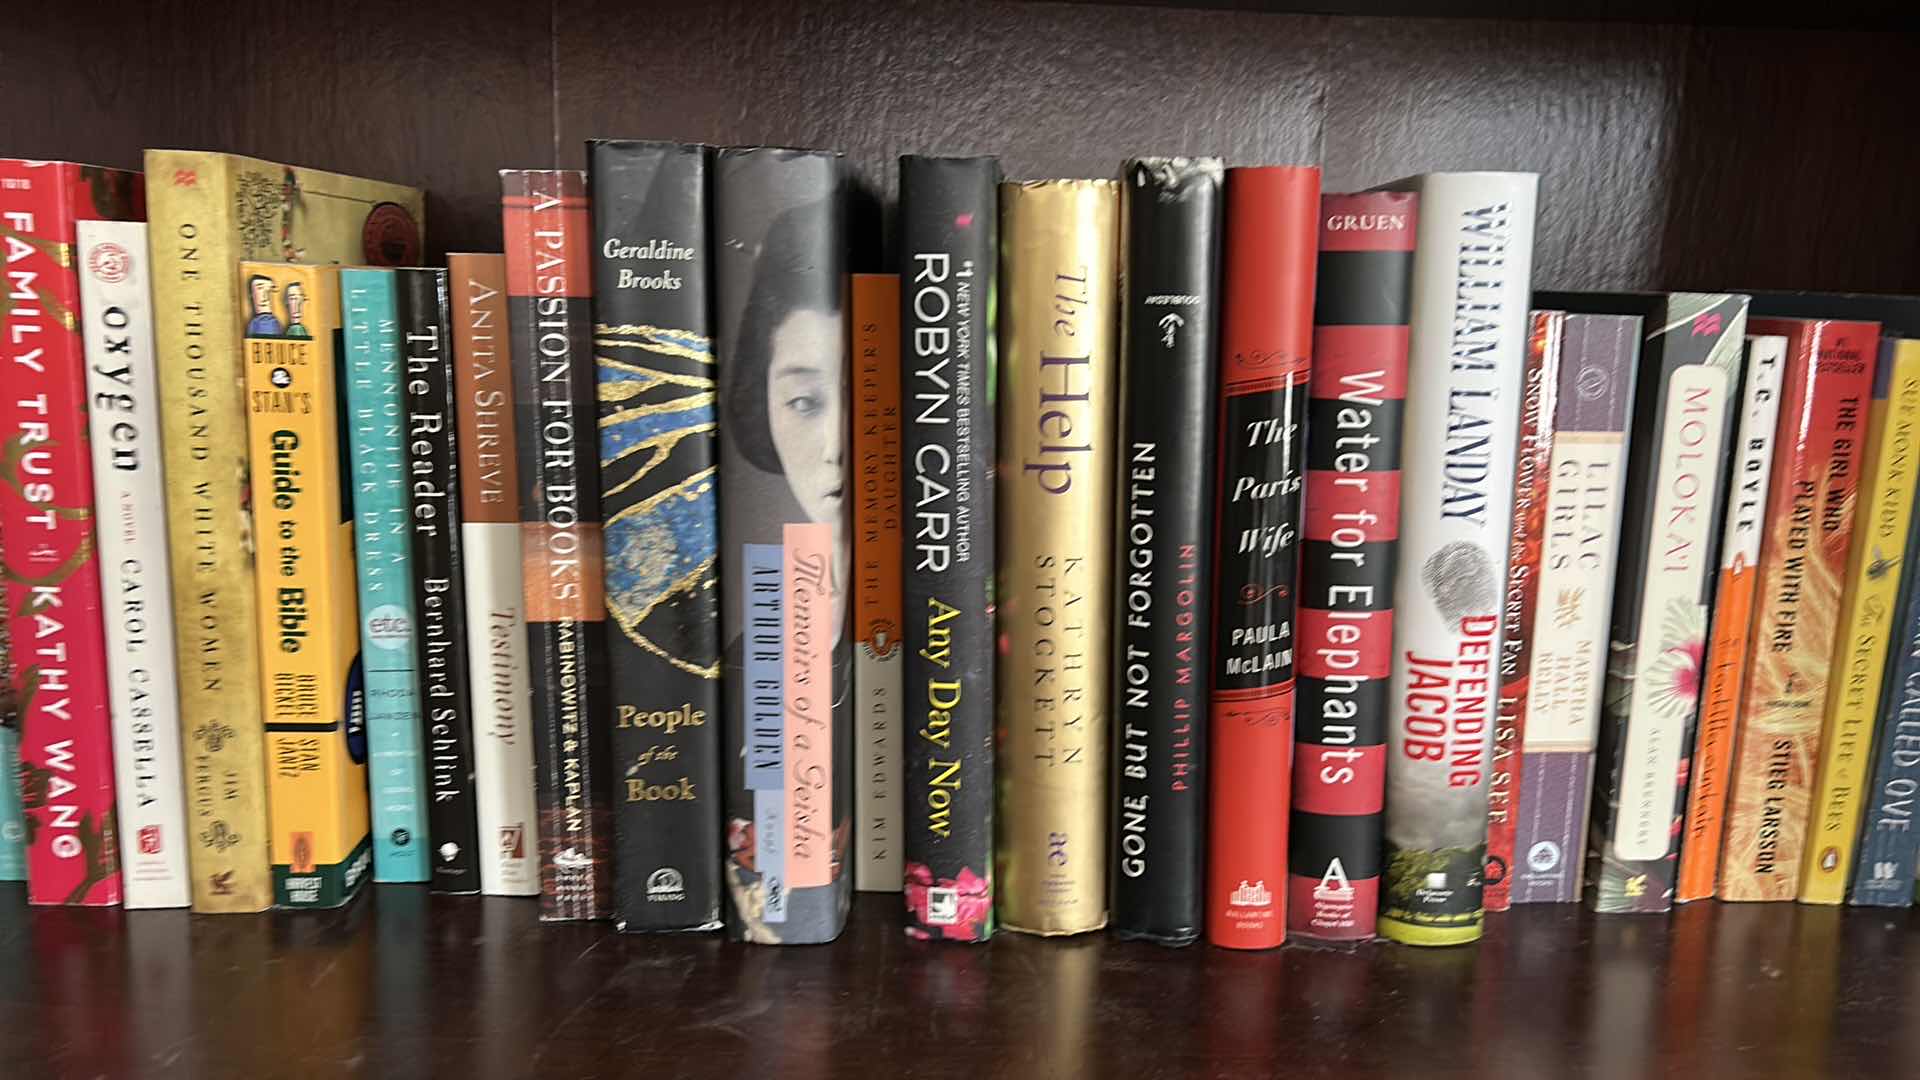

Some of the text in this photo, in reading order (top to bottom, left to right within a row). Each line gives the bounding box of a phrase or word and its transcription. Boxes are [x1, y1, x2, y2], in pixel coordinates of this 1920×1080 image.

[603, 238, 695, 262] Geraldine
[1328, 214, 1405, 232] GRUEN
[3, 210, 45, 372] FAMILY
[617, 268, 683, 291] Brooks
[957, 282, 971, 317] NEW
[252, 342, 308, 366] BRUCE
[957, 320, 971, 358] YORK
[957, 363, 971, 405] TIMES
[1023, 266, 1092, 496] The Help
[1440, 201, 1513, 530] WILLIAM LANDAY
[93, 306, 141, 472] oxygen
[252, 391, 312, 415] STAN'S
[407, 326, 446, 537] The Reader
[468, 280, 504, 505] ANITA SHREVE
[533, 191, 582, 599] A PASSION FOR BOOKS
[914, 253, 951, 571] ROBYN CARR
[1247, 418, 1298, 447] The
[1523, 368, 1544, 430] SNOW
[1837, 397, 1859, 431] THE
[16, 393, 57, 531] TRUST
[177, 222, 224, 692] ONE THOUSAND WHITE WOMEN
[350, 289, 384, 592] LITTLE BLACK DRESS
[376, 320, 406, 564] MENNONITE IN A
[884, 406, 898, 530] DAUGHTER
[957, 409, 971, 502] BESTSELLING
[1516, 434, 1541, 514] FLOWER
[1664, 386, 1711, 573] MOLOKA'I
[1736, 437, 1764, 535] BOYLE
[1829, 440, 1850, 480] GIRL
[1879, 378, 1918, 537] SUE MONK KIDD
[864, 451, 879, 542] MEMORY
[1232, 471, 1302, 503] Paris
[1550, 459, 1580, 571] GIRLS
[1579, 460, 1610, 571] LILAC
[1822, 489, 1844, 531] WHO
[270, 429, 307, 655] Guide to the Bible
[957, 506, 972, 562] AUTHOR
[1238, 523, 1296, 554] Wife
[1316, 371, 1386, 785] Water for Elephants
[1773, 481, 1815, 652] PLAYED WITH FIRE
[752, 566, 784, 662] ARTHUR
[1231, 621, 1291, 645] PAULA
[1505, 565, 1529, 634] SECRET
[31, 587, 71, 721] KATHY
[121, 558, 158, 809] CAROL CASSELLA
[296, 674, 316, 718] BRUCE
[424, 578, 459, 802] Bernhard Schlink
[488, 607, 519, 746] Testimony
[1034, 556, 1056, 768] STOCKETT
[1062, 558, 1083, 765] KATHRYN
[1122, 442, 1156, 878] GONE BUT NOT FORGOTTEN
[1171, 545, 1197, 792] PHILLIP MARGOLIN
[1226, 649, 1293, 675] McLAIN
[1501, 639, 1523, 675] FAN
[1551, 657, 1571, 709] HALL
[1568, 640, 1592, 726] MARTHA
[1847, 634, 1877, 709] SECRET
[556, 617, 582, 832] RABINOWITZ & KAPLAN
[616, 704, 706, 734] People
[752, 680, 783, 771] GOLDEN
[785, 549, 827, 860] Memoirs of a Geisha
[919, 597, 961, 839] Any Day Now
[1404, 651, 1453, 763] JACOB
[1449, 615, 1498, 789] DEFENDING
[1492, 697, 1518, 762] LISA
[1838, 719, 1863, 761] LIFE
[276, 738, 299, 778] JANTZ
[299, 738, 320, 772] STAN
[625, 778, 697, 802] Book
[638, 745, 678, 765] of the
[872, 688, 887, 861] KIM EDWARDS
[1488, 772, 1508, 824] SEE
[1765, 741, 1793, 788] STIEG
[1756, 796, 1785, 873] LARSSON
[1824, 787, 1851, 831] BEES
[1876, 779, 1917, 831] OVE
